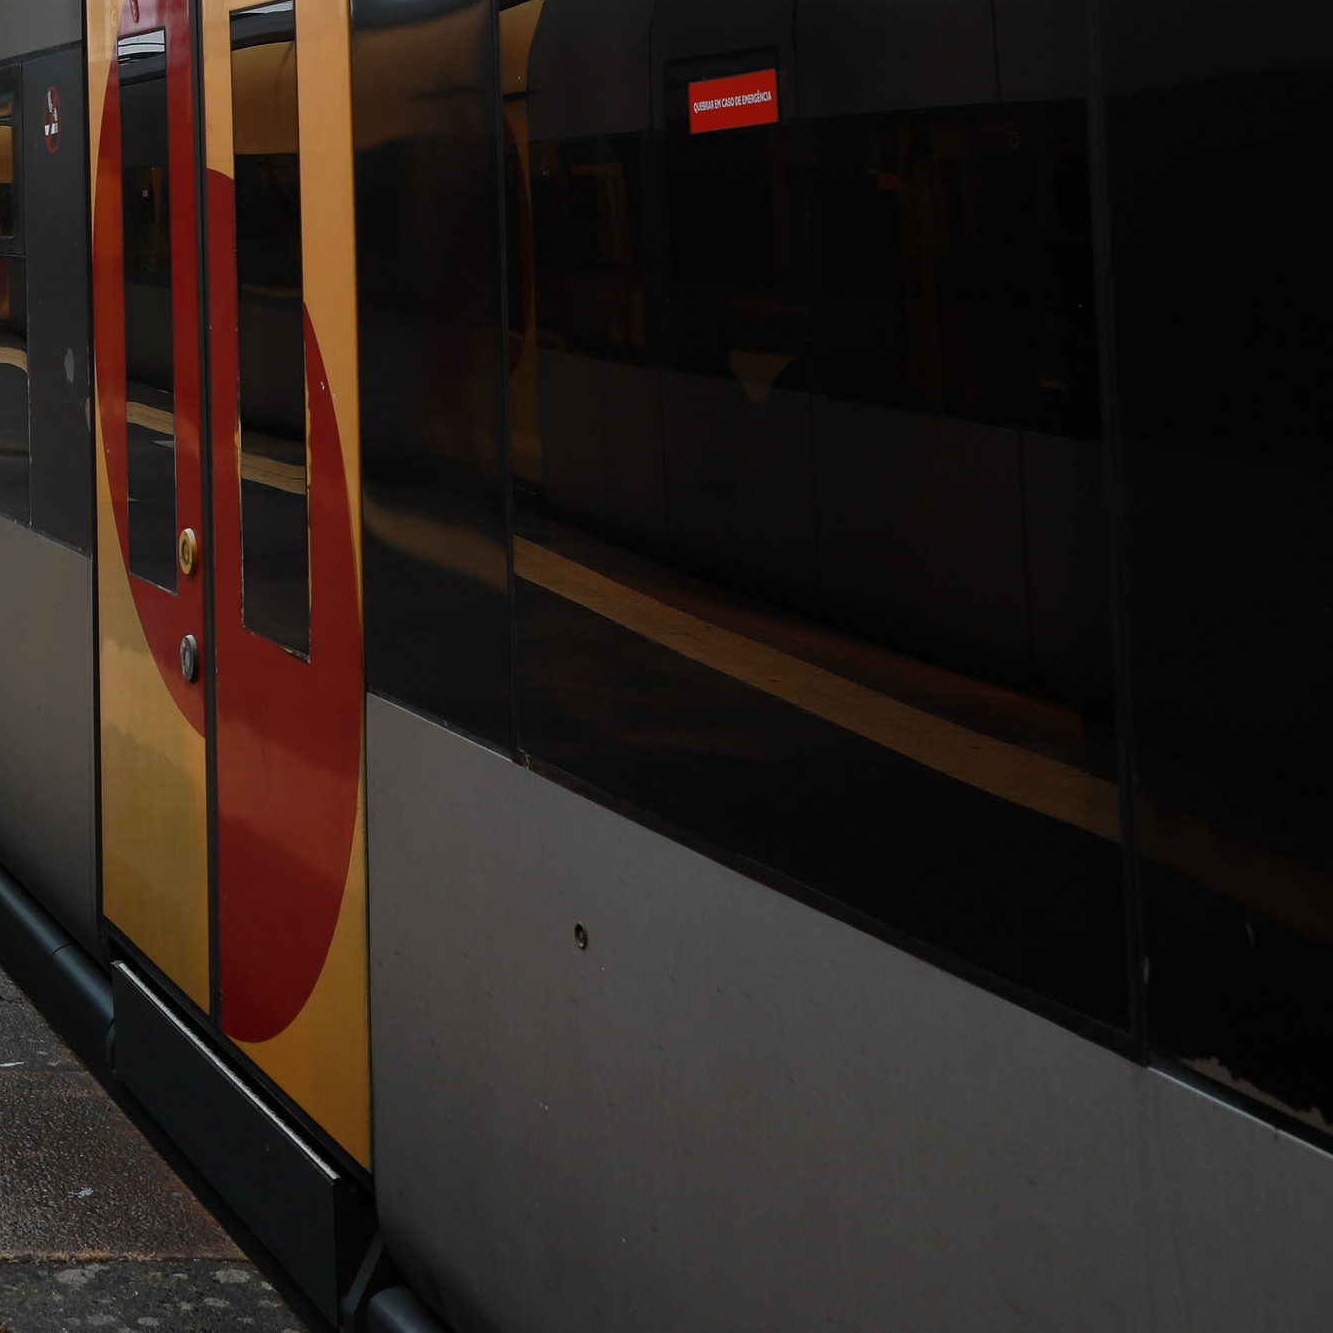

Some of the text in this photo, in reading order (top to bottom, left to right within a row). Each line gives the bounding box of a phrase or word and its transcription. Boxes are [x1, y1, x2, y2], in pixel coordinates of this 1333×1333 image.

[693, 90, 773, 114] QUEBRAR EM CASO DE EMERGÊNCIA
